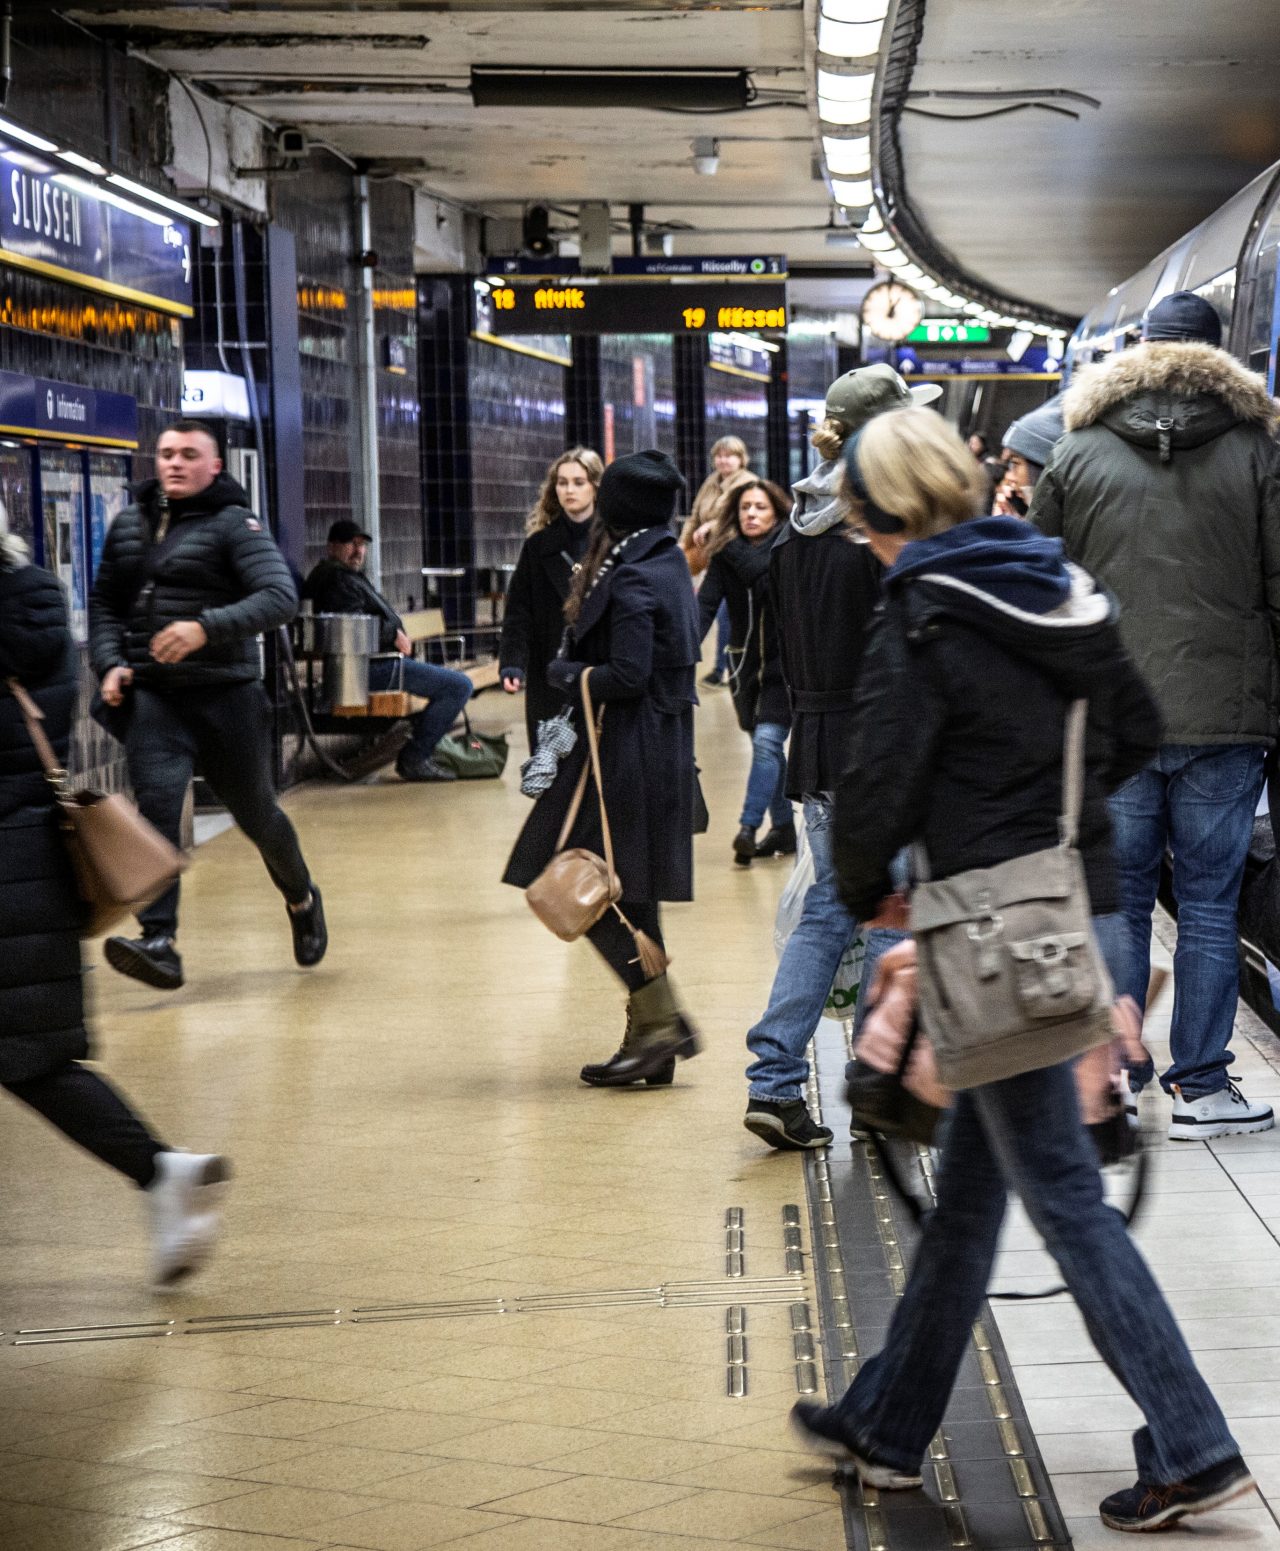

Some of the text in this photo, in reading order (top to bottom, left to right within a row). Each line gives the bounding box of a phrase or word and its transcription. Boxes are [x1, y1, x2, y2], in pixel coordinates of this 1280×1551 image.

[11, 169, 82, 247] SLUSSEN
[701, 259, 748, 274] Hässelby
[491, 288, 585, 309] 18 Alvik
[682, 307, 706, 328] 19
[56, 393, 87, 422] Information
